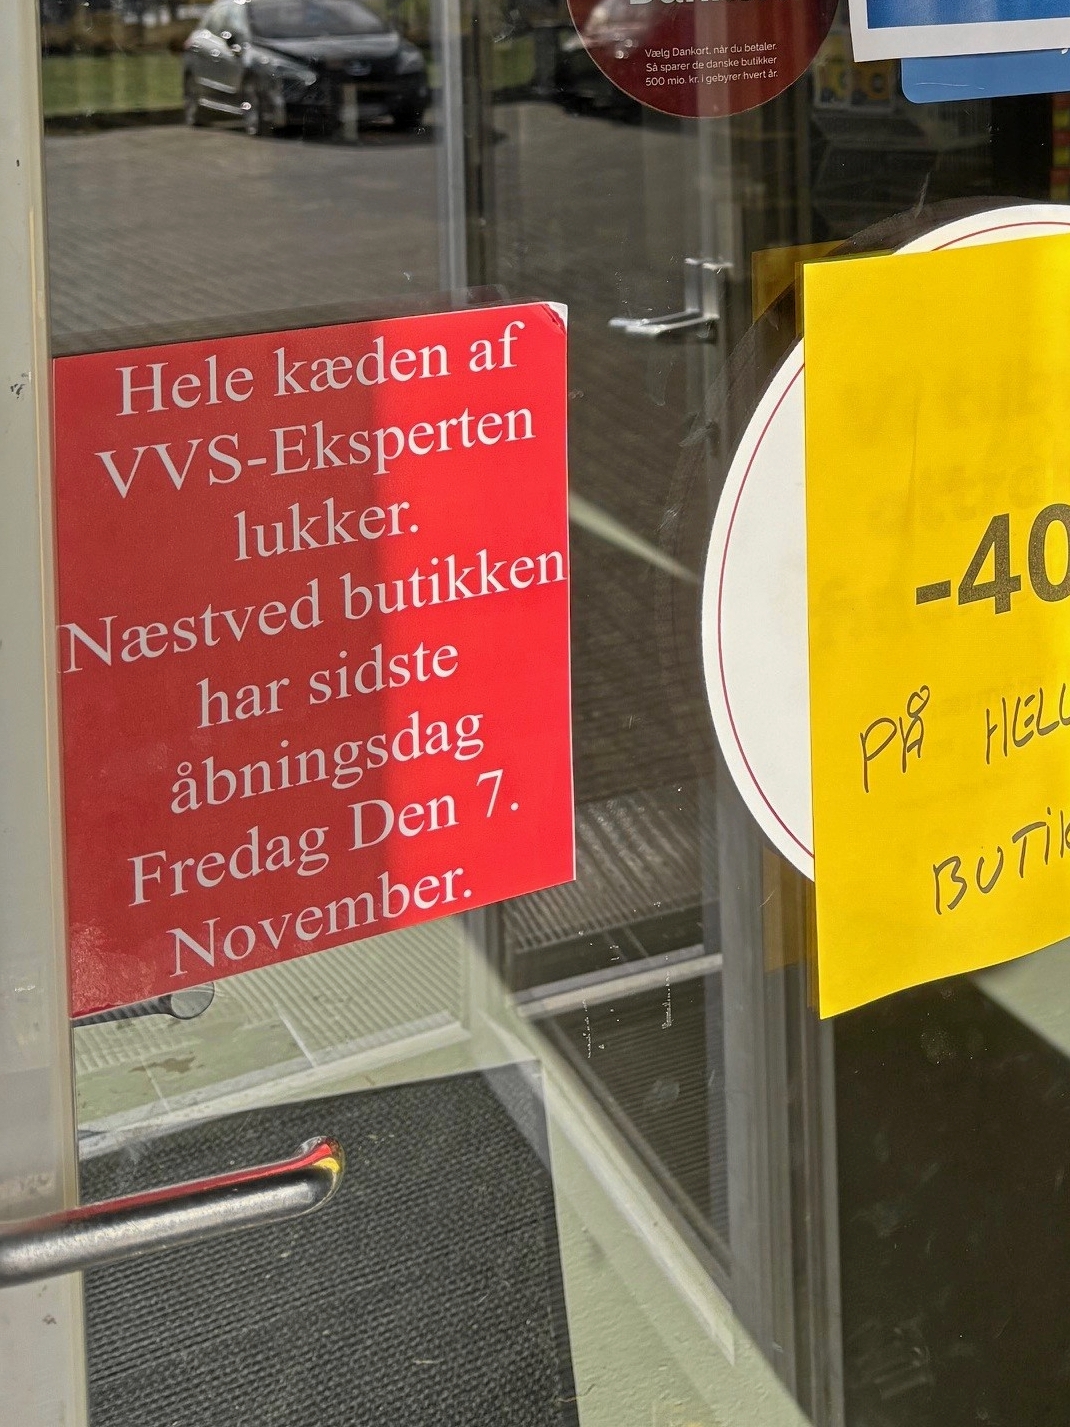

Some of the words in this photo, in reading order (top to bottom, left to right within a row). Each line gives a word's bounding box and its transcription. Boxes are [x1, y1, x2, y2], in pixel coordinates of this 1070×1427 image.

[645, 49, 669, 59] Vælg
[714, 44, 728, 54] når
[731, 44, 742, 53] du
[745, 42, 777, 52] betaler.
[645, 77, 665, 86] 500
[668, 75, 687, 85] mio.
[689, 74, 699, 84] kr.
[706, 72, 741, 84] gebyrer
[743, 70, 766, 80] hvert
[768, 69, 778, 78] år.
[646, 62, 658, 72] Så
[661, 62, 689, 73] sparer
[692, 60, 704, 70] de
[707, 58, 740, 69] danske
[741, 56, 777, 66] butikker
[115, 355, 255, 416] Hele
[274, 337, 450, 397] kæden
[468, 321, 525, 372] af
[95, 406, 536, 499] VVS-Eksperten
[234, 497, 419, 562] lukker.
[56, 579, 323, 674] Næstved
[340, 549, 568, 620] butikken
[197, 677, 290, 729] har
[308, 641, 460, 706] sidste
[170, 711, 485, 815] åbningsdag
[860, 684, 930, 793] PÅ
[127, 825, 330, 908] Fredag
[347, 794, 459, 851] Den
[476, 768, 519, 818] 7.
[166, 867, 473, 978] November.
